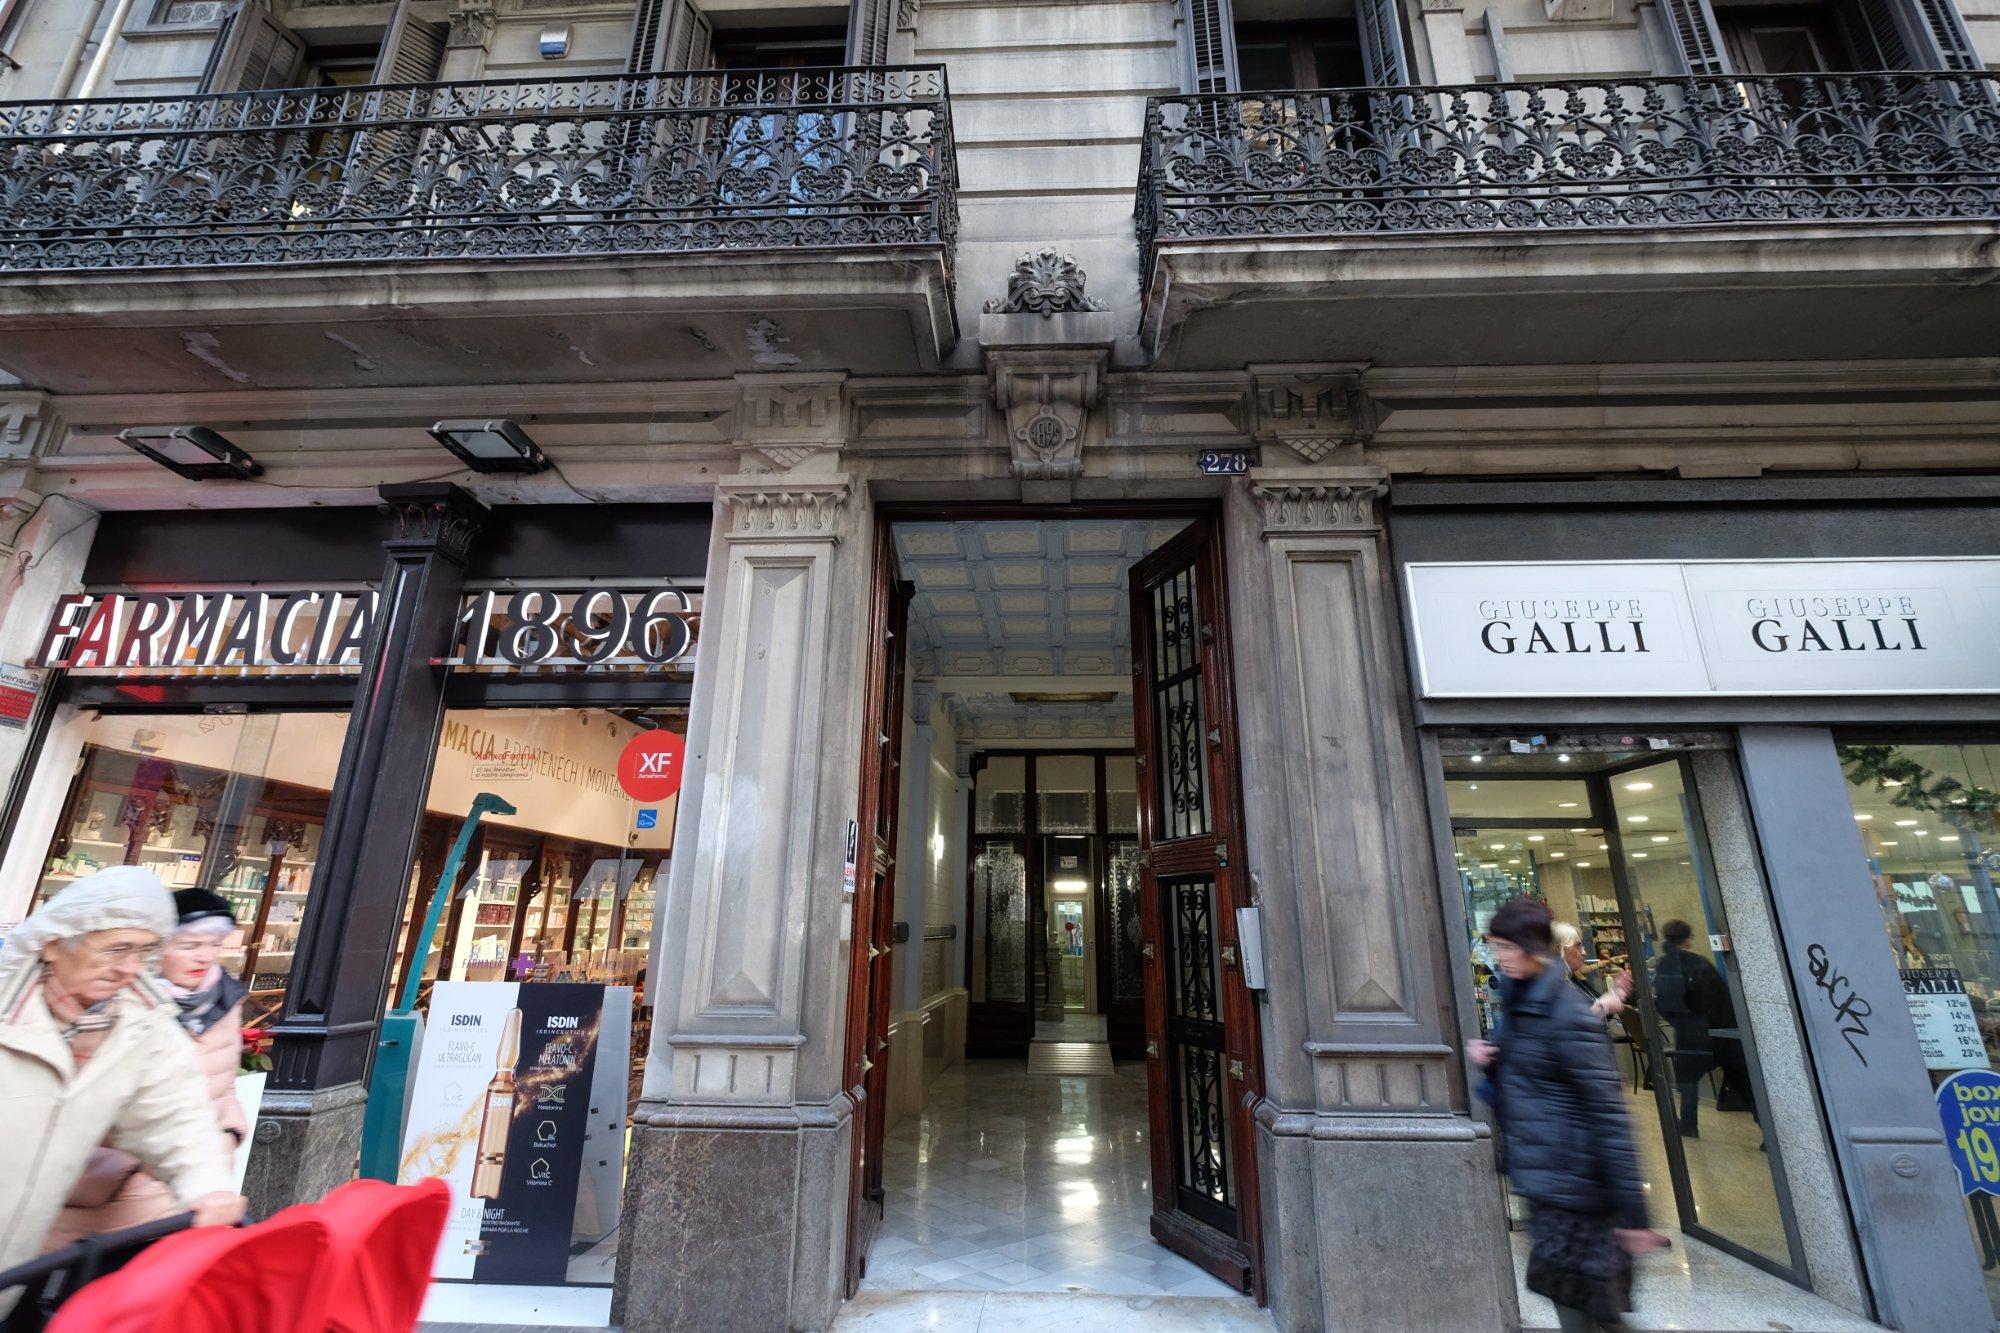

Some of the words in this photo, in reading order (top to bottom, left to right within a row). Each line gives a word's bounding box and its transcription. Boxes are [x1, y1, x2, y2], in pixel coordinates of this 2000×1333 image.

[1207, 453, 1247, 472] 278
[1480, 599, 1642, 620] GIUSEPPE
[1747, 597, 1915, 618] GIUSEPPE
[35, 592, 380, 667] FARMACIA
[460, 587, 692, 664] 1896
[1752, 619, 1927, 652] GALLI
[1481, 621, 1651, 655] GALLI
[639, 752, 672, 772] XF
[1902, 979, 1963, 994] GALLI
[451, 1014, 482, 1026] ISDIN
[547, 1015, 579, 1028] ISDIN
[483, 1208, 505, 1220] NIGHT
